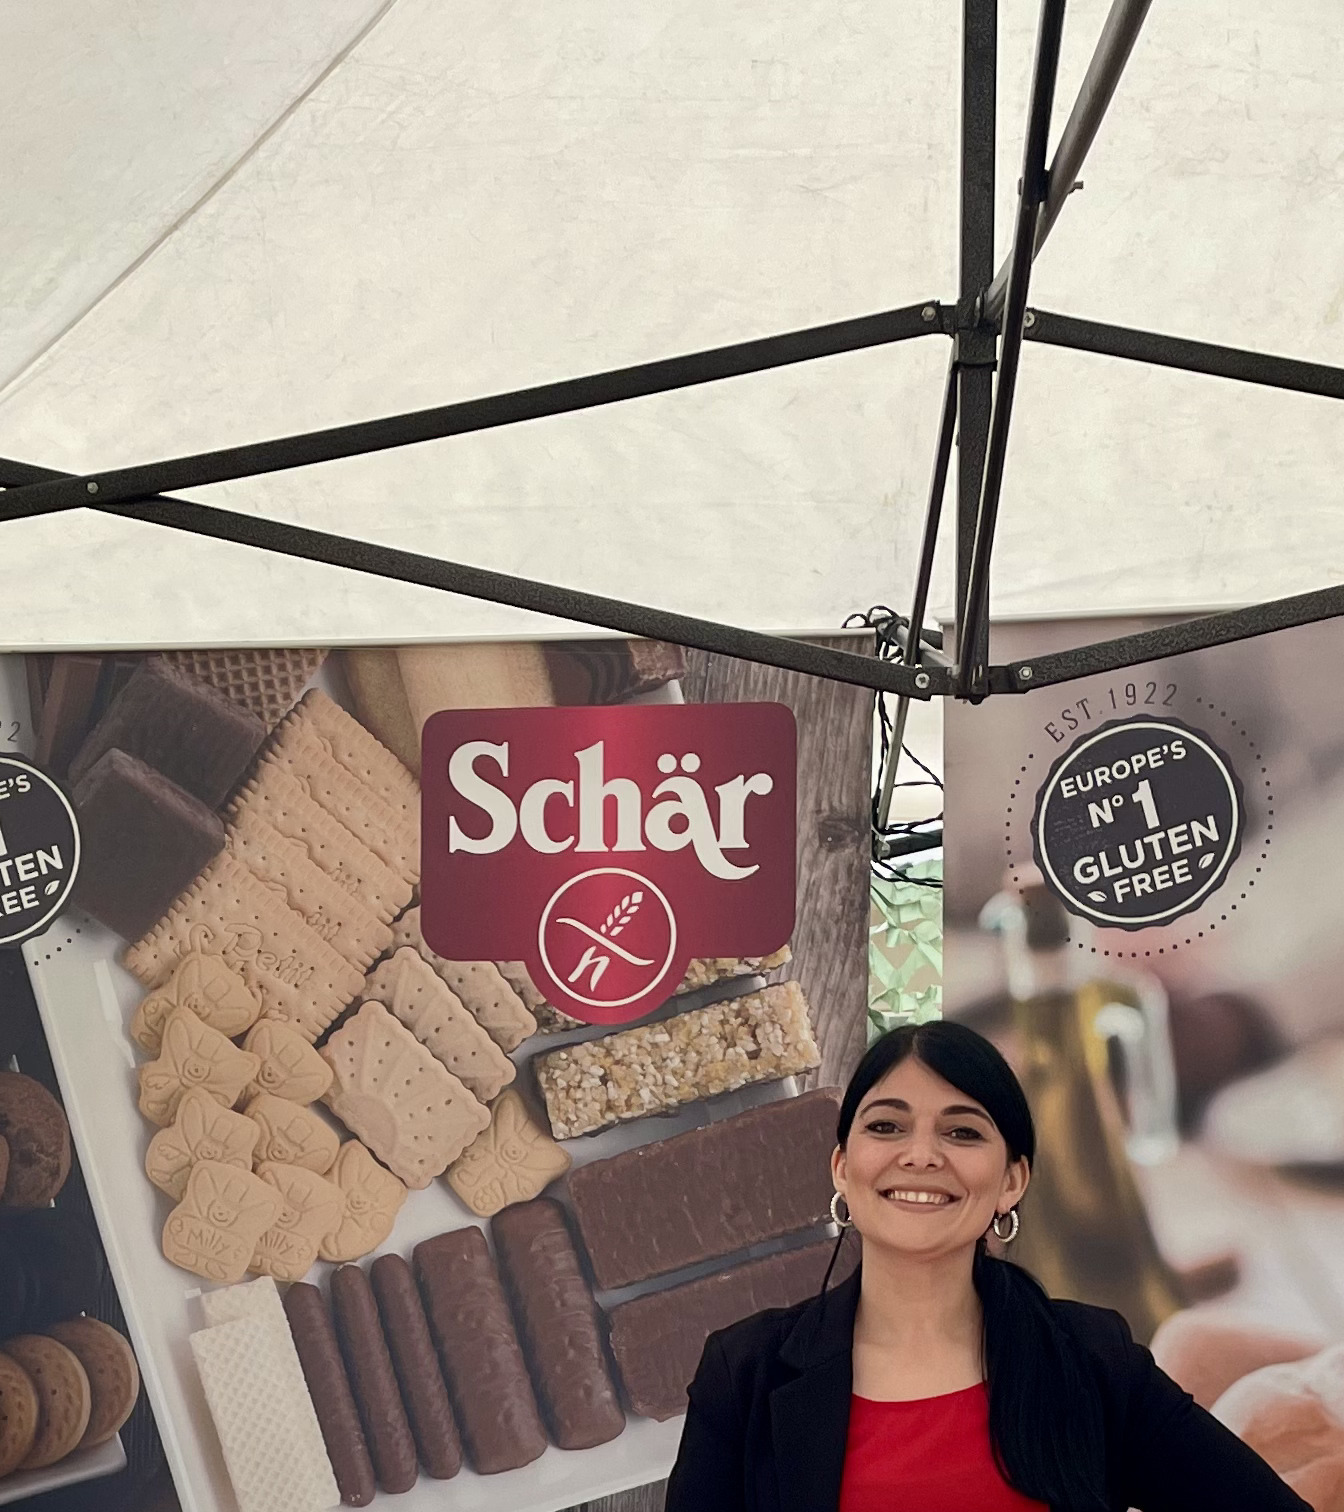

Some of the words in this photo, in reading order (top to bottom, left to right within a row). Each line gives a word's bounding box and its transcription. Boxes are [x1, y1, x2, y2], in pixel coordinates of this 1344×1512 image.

[1108, 681, 1179, 710] 1922
[448, 740, 774, 880] Schär
[1132, 779, 1161, 830] 1
[1073, 815, 1220, 885] GLUTEN
[1112, 858, 1194, 904] FREE
